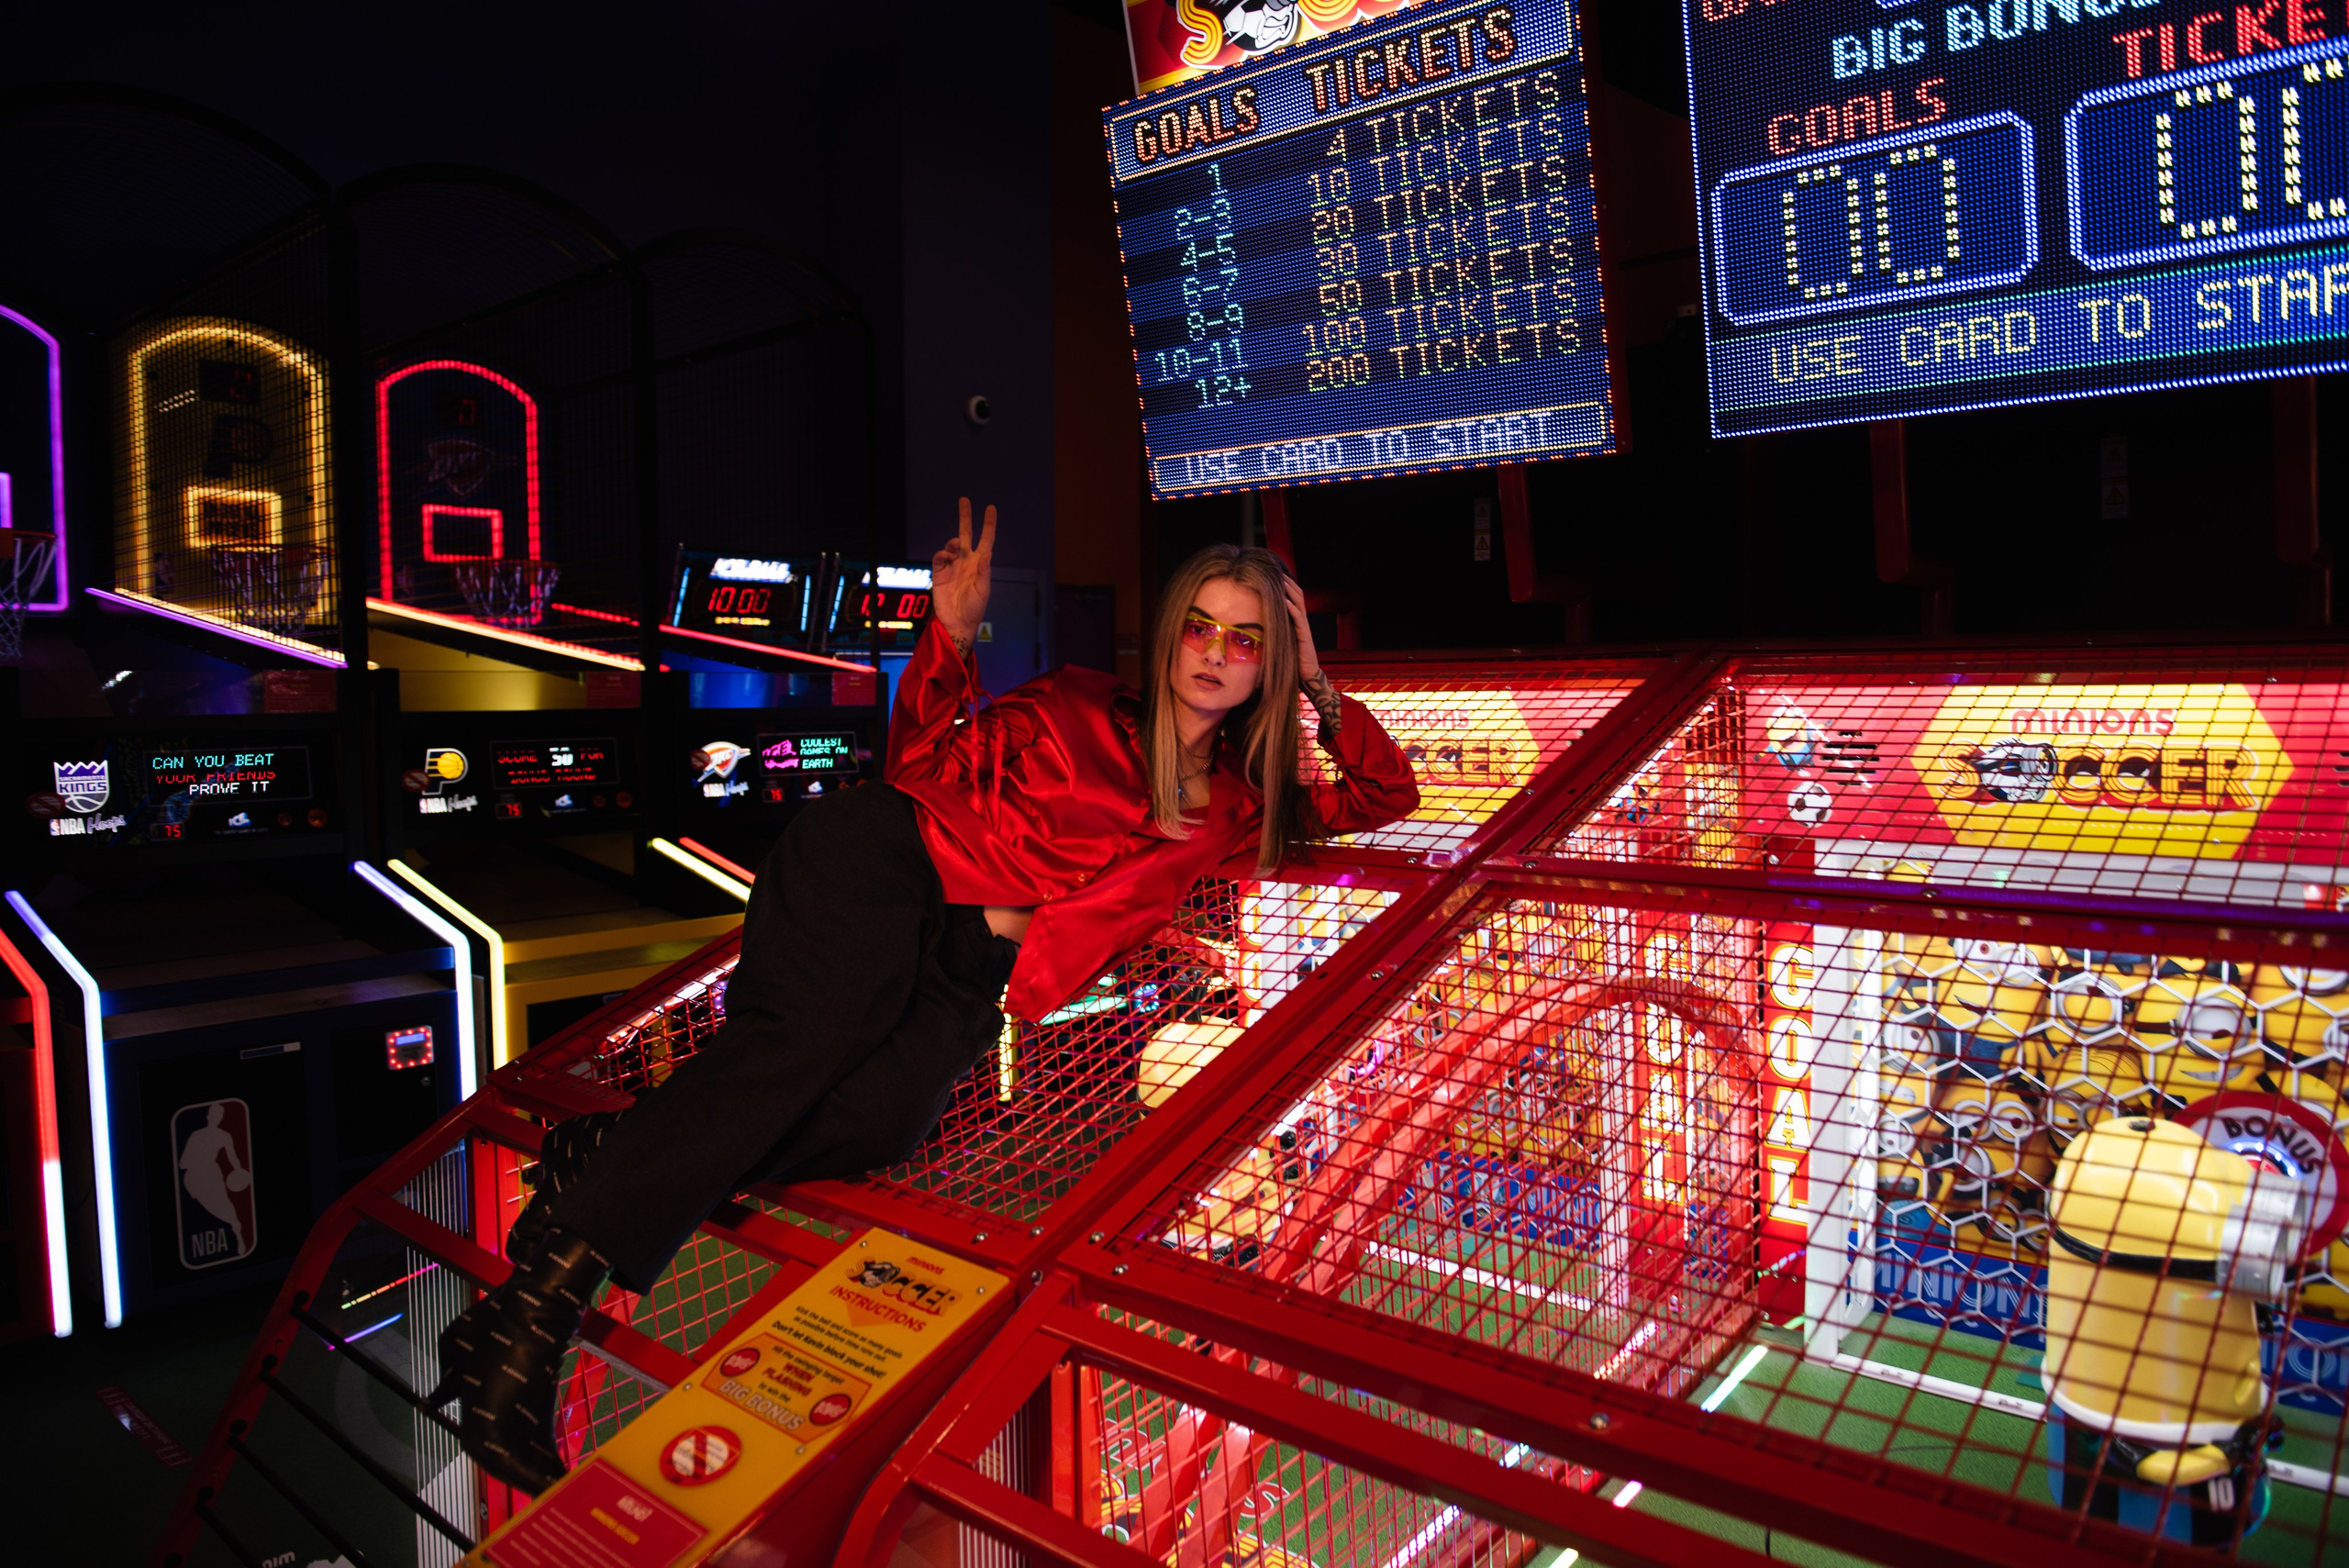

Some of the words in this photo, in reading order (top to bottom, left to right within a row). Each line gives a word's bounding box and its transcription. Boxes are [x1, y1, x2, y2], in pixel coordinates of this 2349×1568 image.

[1832, 18, 1926, 80] BIG
[1945, 0, 2156, 52] BON
[2112, 0, 2349, 78] TICKE
[1134, 87, 1259, 163] GOALS
[1305, 8, 1516, 111] TICKETS
[1767, 77, 1947, 155] GOALS
[1208, 163, 1229, 196] 1
[1327, 128, 1347, 163] 4
[1365, 72, 1560, 152] TICKETS
[1174, 197, 1232, 241] 2-3
[1307, 167, 1351, 207] 10
[1370, 113, 1564, 192] TICKETS
[1180, 232, 1236, 272] 4-5
[1311, 205, 1355, 244] 20
[1374, 155, 1567, 229] TICKETS
[1781, 143, 1959, 300] 00
[1182, 268, 1239, 308] 6-7
[1315, 242, 1359, 281] 30
[1378, 196, 1571, 264] TICKETS
[1186, 303, 1245, 342] 8-9
[1318, 279, 1363, 317] 50
[1381, 238, 1574, 303] TICKETS
[1154, 339, 1249, 382] 10-11
[1302, 316, 1366, 357] 100
[1386, 277, 1577, 341] TICKETS
[1194, 375, 1252, 409] 12+
[1307, 352, 1370, 392] 200
[1389, 318, 1581, 379] TICKETS
[1771, 334, 1863, 384] USE
[1898, 310, 2037, 367] CARD
[2078, 293, 2152, 344] TO
[1184, 450, 1241, 484] USE
[1261, 436, 1343, 478] CARD
[1364, 430, 1409, 464] TO
[1434, 412, 1554, 458] START
[59, 782, 107, 794] KINGS
[152, 756, 184, 770] CAN
[194, 754, 225, 768] YOU
[234, 752, 274, 767] BEAT
[189, 782, 240, 795] PROVE
[251, 781, 270, 794] IT
[802, 758, 834, 770] EARTH
[59, 817, 86, 836] NBA
[164, 824, 181, 838] 75
[506, 804, 520, 817] 75
[2221, 1115, 2324, 1174] BONUS
[191, 1228, 228, 1260] NBA
[829, 1284, 928, 1333] INSTRUCTIONS
[782, 1362, 817, 1384] WHEN
[802, 1336, 825, 1349] Kevin
[823, 1344, 846, 1360] block
[842, 1356, 865, 1369] your
[718, 1378, 751, 1401] BIG
[744, 1392, 806, 1431] BONUS
